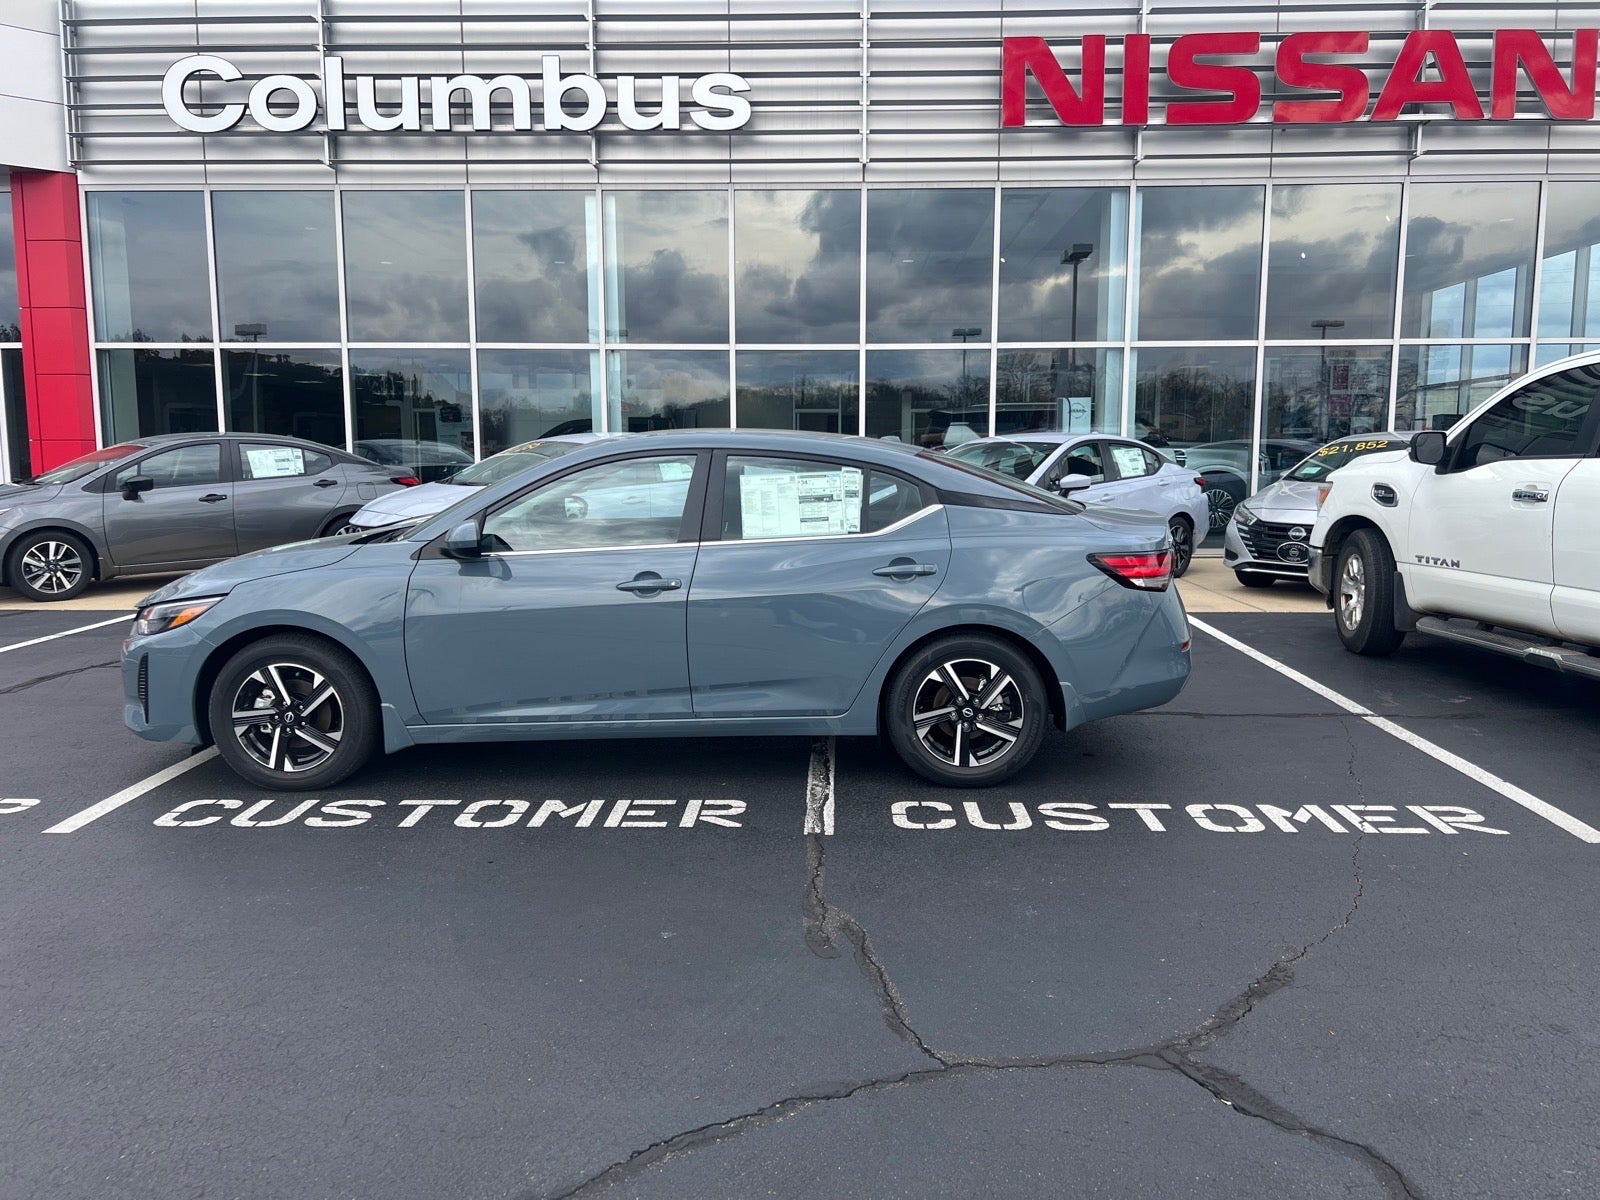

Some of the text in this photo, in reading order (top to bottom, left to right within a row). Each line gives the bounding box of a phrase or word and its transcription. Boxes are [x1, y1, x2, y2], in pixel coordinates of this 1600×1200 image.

[161, 55, 752, 133] Columbus
[1001, 29, 1599, 128] NISSAN
[1318, 440, 1389, 456] $21,852
[1415, 555, 1460, 568] TITAN
[153, 799, 747, 829] CUSTOMER
[891, 801, 1510, 836] CUSTOMER
